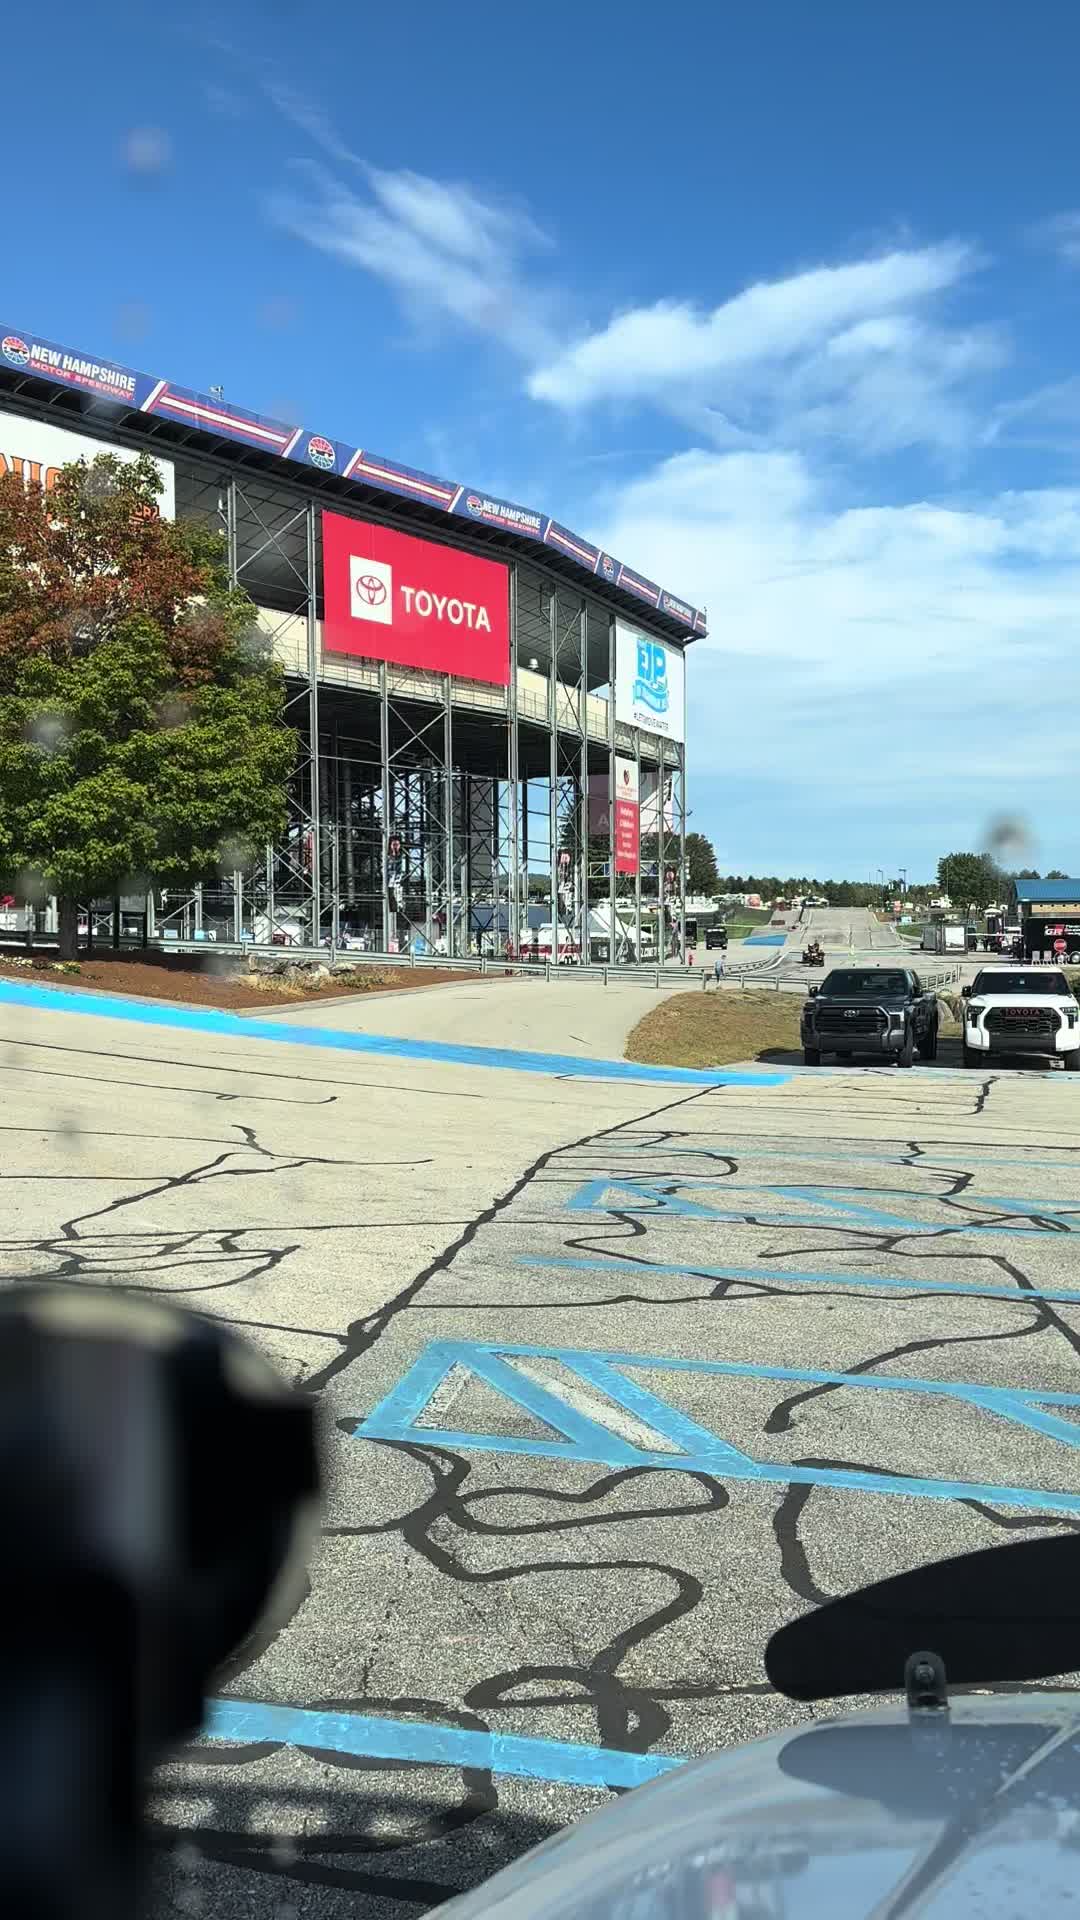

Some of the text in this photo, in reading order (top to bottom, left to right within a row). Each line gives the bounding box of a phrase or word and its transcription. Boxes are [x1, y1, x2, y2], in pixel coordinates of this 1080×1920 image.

[30, 360, 133, 400] MOTOR SPEEDWAY
[31, 344, 136, 392] NEW HAMPSHIRE
[482, 500, 541, 529] NEW HAMPSHIRE
[401, 585, 491, 633] TOYOTA
[1005, 1007, 1040, 1016] TOYOTA
